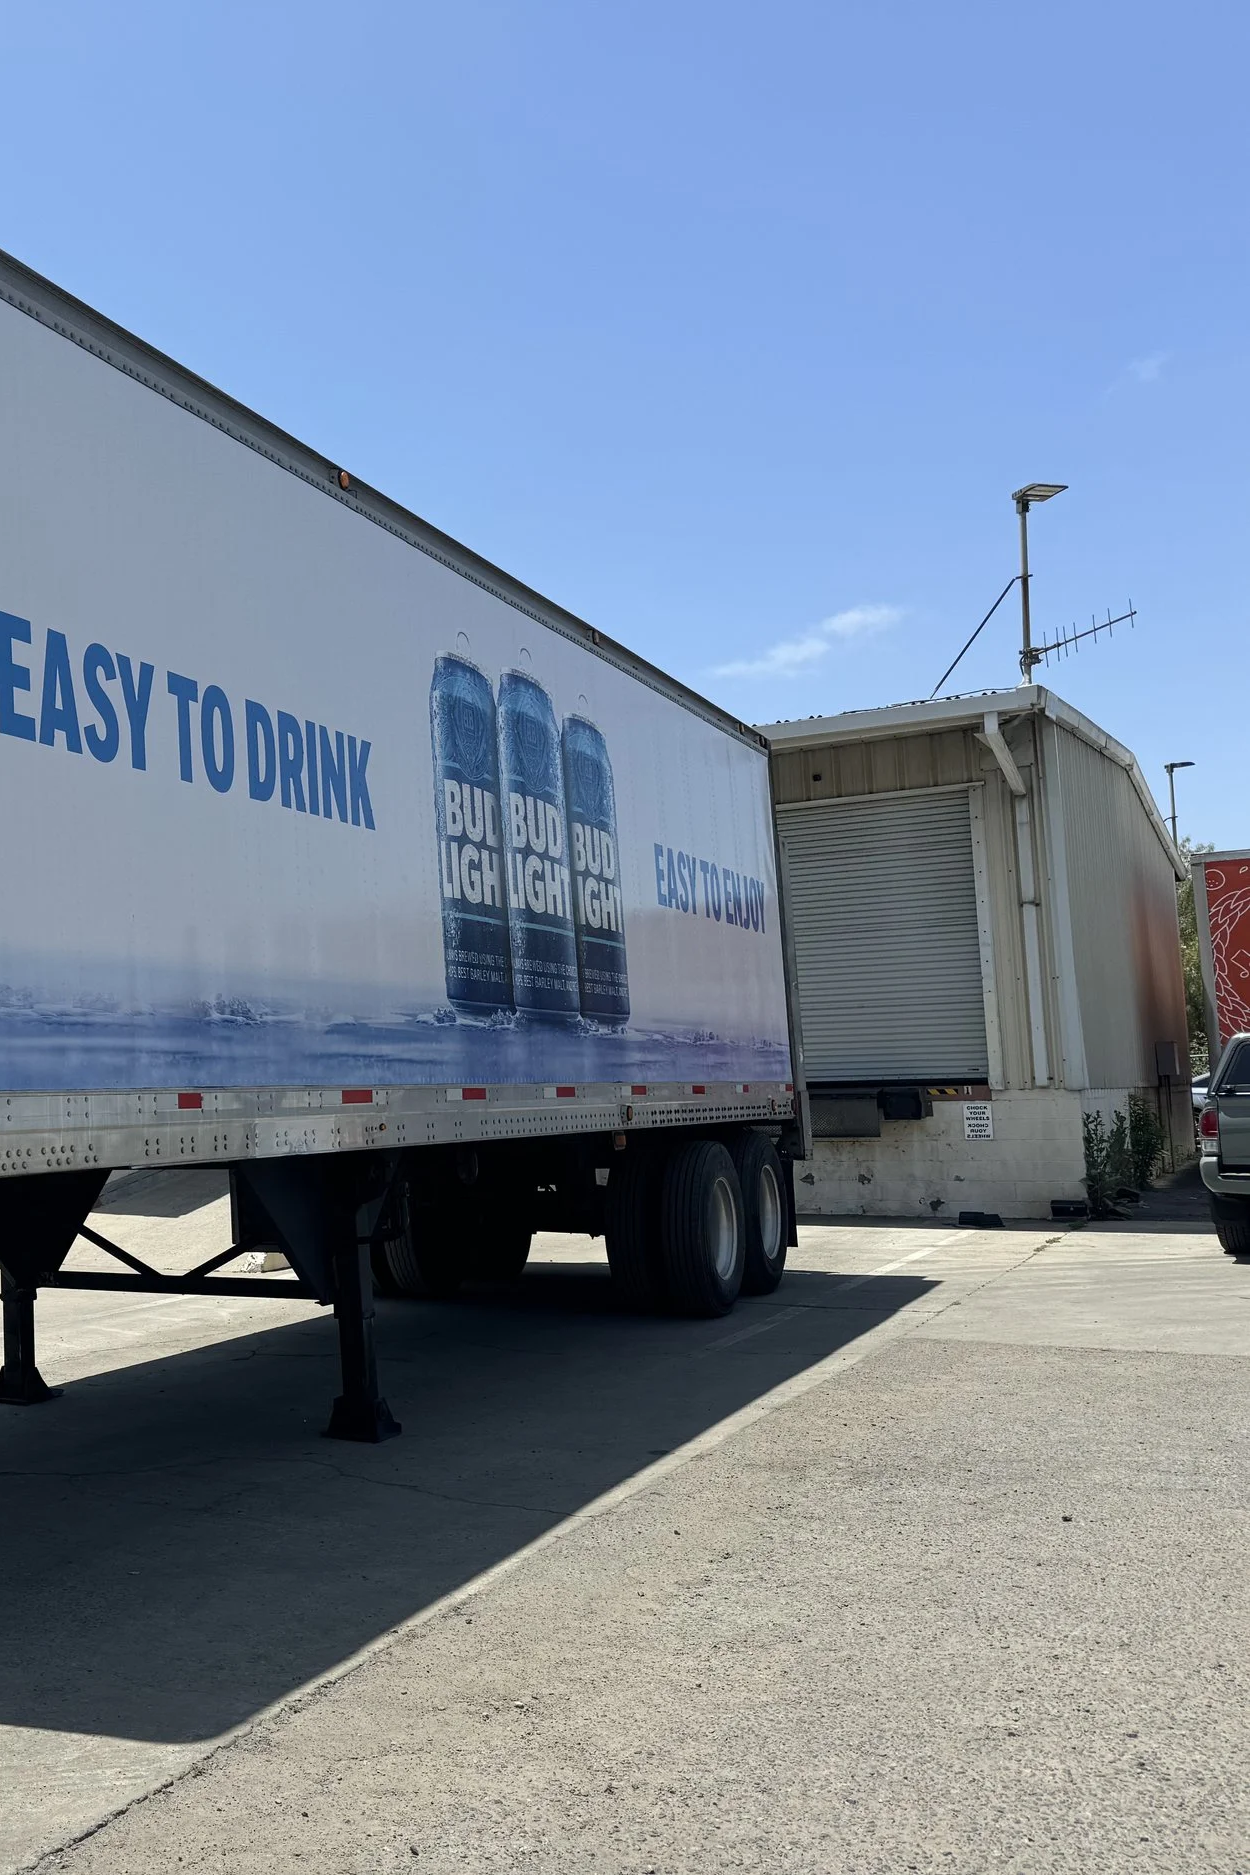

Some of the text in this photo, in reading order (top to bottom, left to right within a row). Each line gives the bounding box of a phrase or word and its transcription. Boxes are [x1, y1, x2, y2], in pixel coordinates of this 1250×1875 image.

[167, 670, 235, 793] TO
[245, 698, 376, 831] DRINK
[444, 779, 499, 848] BUD
[509, 792, 563, 859] BUD
[440, 841, 502, 908] LIGH
[571, 822, 615, 880] BUD
[507, 852, 571, 919] LIGHT
[576, 875, 623, 934] IGHT
[654, 842, 766, 934] EASY TO ENJOY
